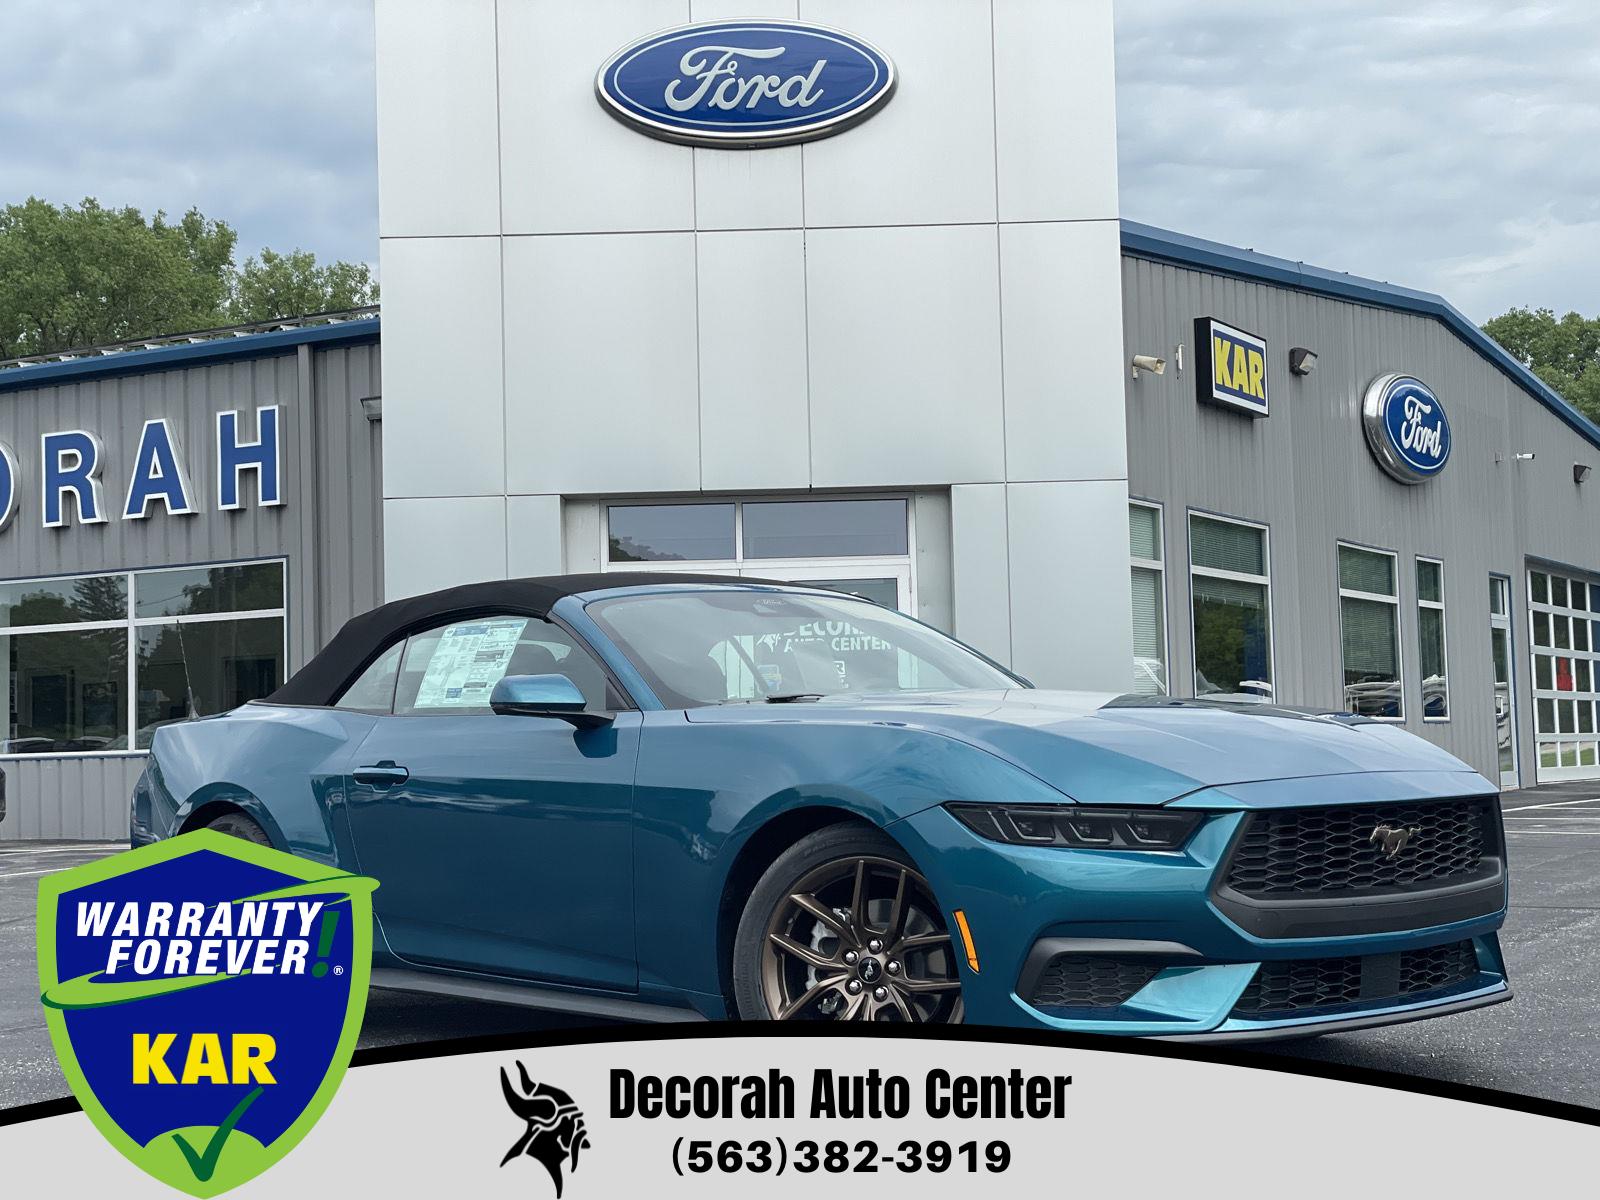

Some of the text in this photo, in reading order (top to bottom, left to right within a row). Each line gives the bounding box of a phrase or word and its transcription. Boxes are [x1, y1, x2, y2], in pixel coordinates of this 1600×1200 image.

[664, 45, 828, 112] Ford
[1214, 336, 1265, 400] KAR
[1401, 395, 1442, 459] Ford
[0, 404, 284, 532] RAH
[831, 635, 892, 652] CENTER
